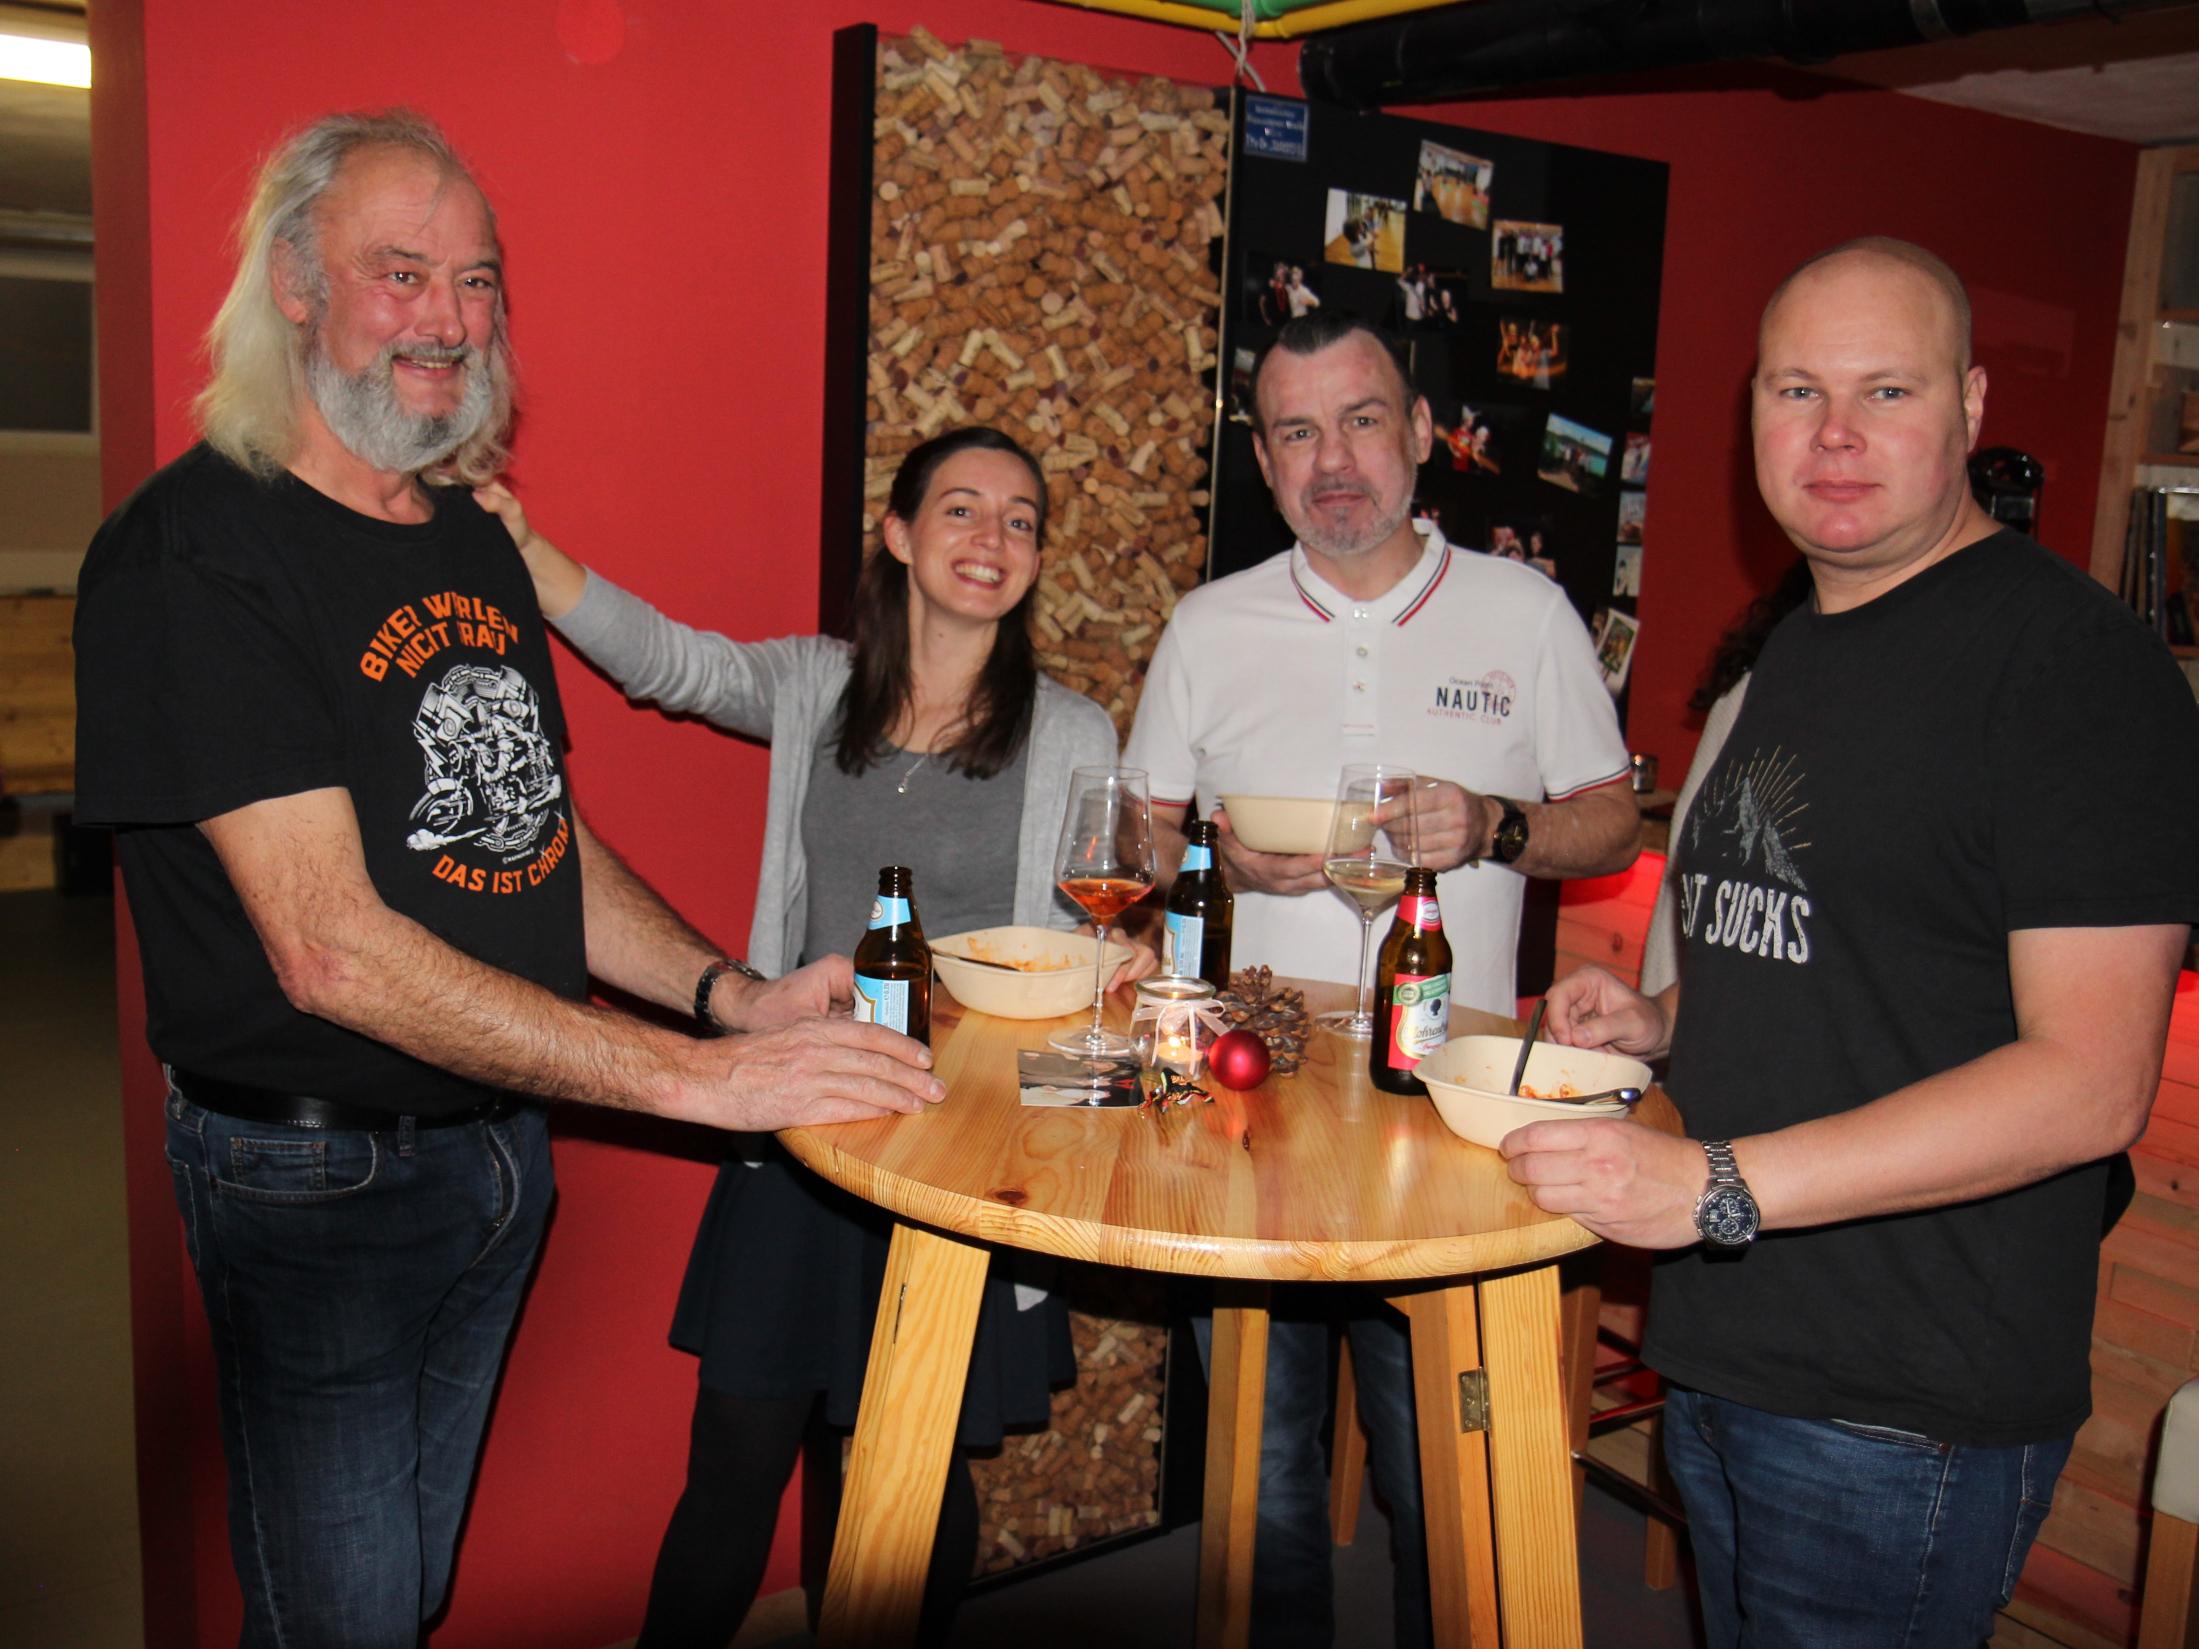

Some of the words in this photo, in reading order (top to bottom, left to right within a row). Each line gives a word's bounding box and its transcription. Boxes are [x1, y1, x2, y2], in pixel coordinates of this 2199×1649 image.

[1436, 687, 1511, 717] NAUTIC
[431, 854, 487, 892] DAS
[492, 870, 523, 894] IST
[1705, 879, 1811, 964] SUCKS
